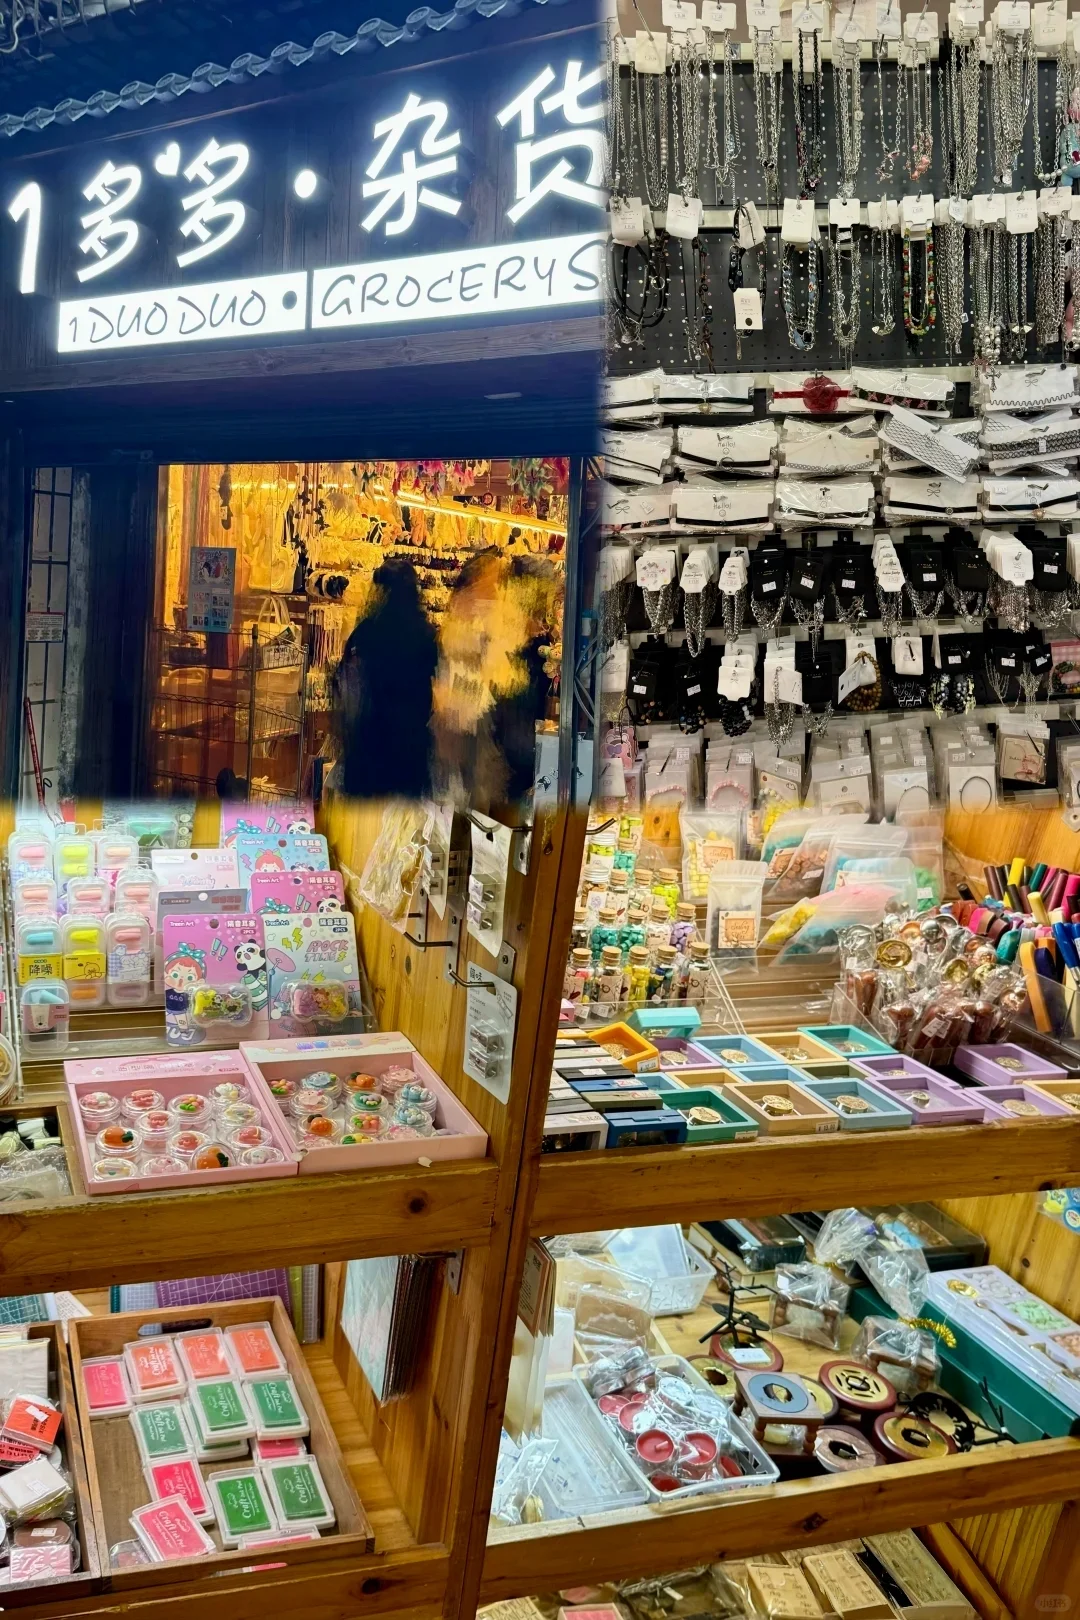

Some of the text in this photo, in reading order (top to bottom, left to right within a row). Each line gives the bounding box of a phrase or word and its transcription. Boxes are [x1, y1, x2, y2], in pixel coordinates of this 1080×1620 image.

[1025, 490, 1041, 498] Hello!
[713, 502, 731, 510] Hello!
[306, 939, 349, 953] ROCK
[304, 952, 336, 962] TIME
[29, 964, 53, 976] 降噪
[149, 1359, 160, 1374] Craft
[268, 1381, 280, 1398] Craft
[218, 1400, 229, 1416] Craft
[152, 1409, 164, 1427] Craft
[296, 1483, 307, 1503] Craft
[238, 1498, 251, 1517] Craft
[157, 1509, 176, 1532] Craft
